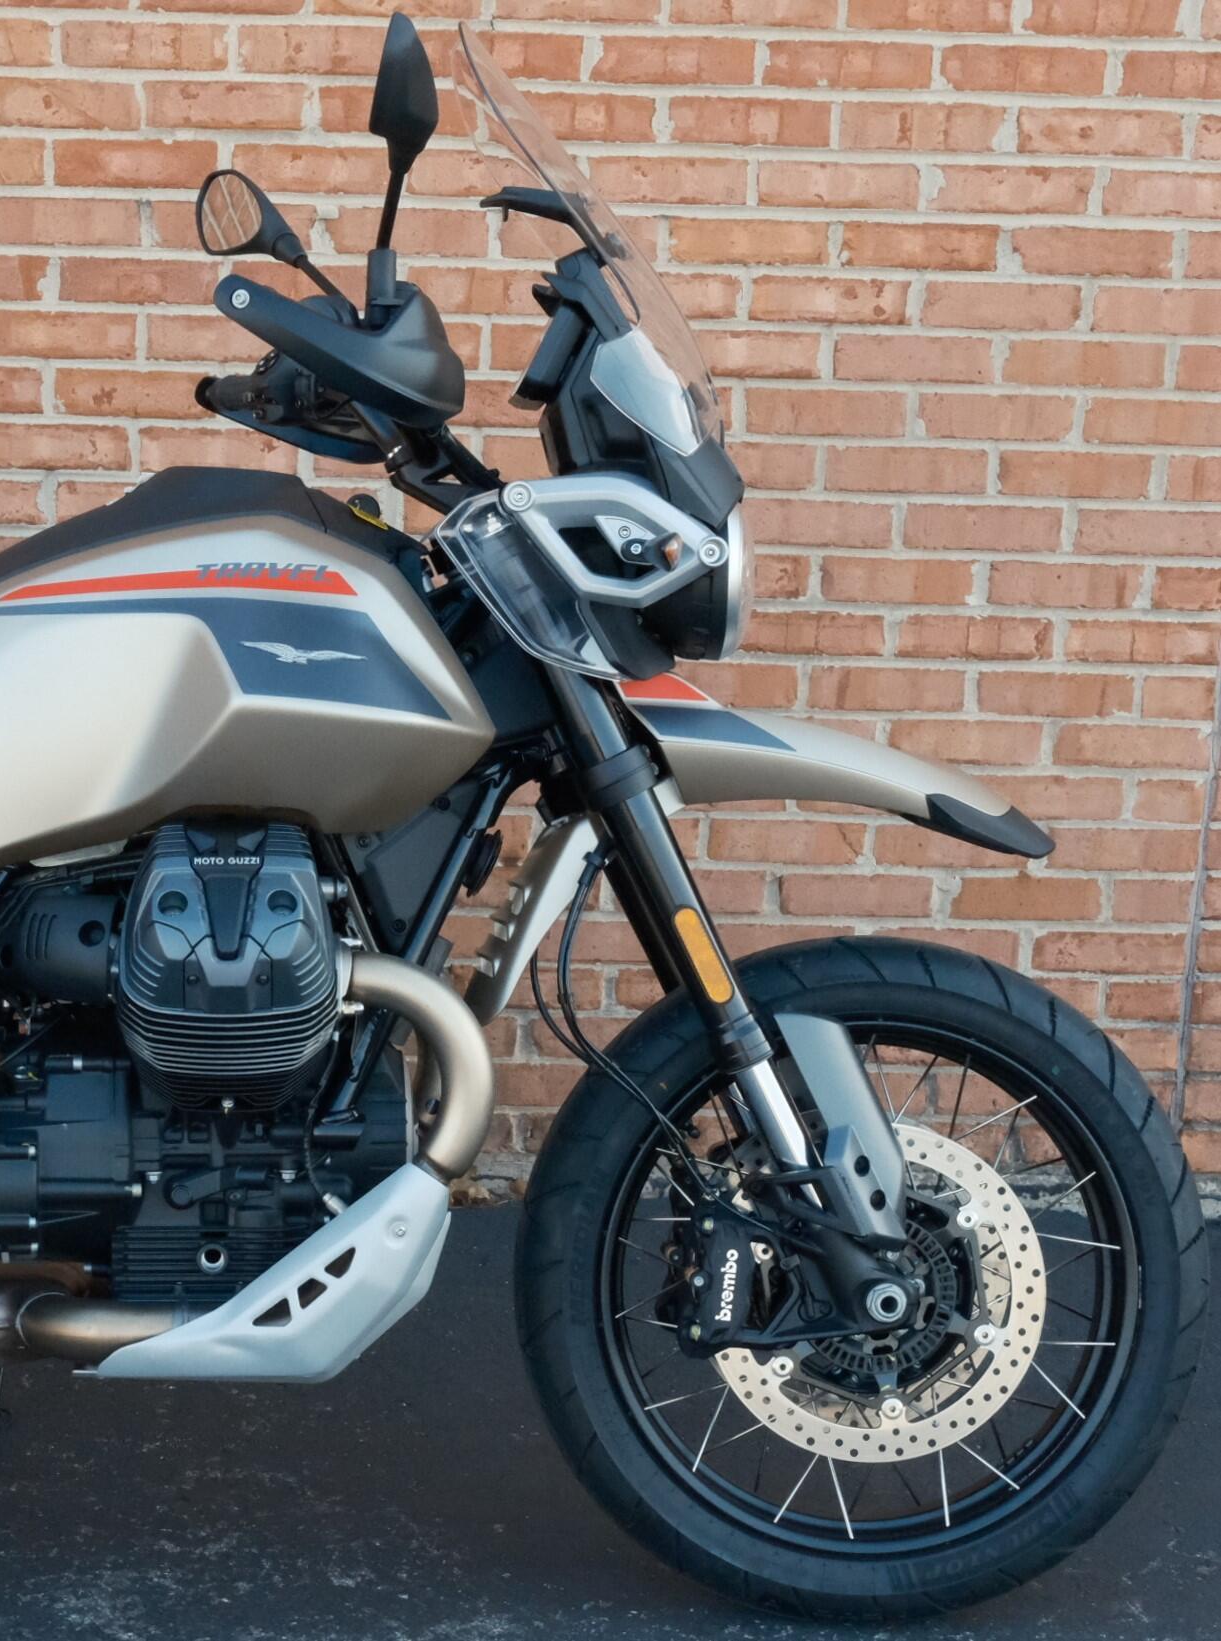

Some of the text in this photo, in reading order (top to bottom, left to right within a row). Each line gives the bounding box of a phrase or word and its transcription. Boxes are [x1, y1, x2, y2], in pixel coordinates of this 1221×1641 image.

[195, 562, 332, 583] TRAVEL
[193, 856, 260, 865] MOTO GUZZI
[714, 1249, 739, 1322] brembo
